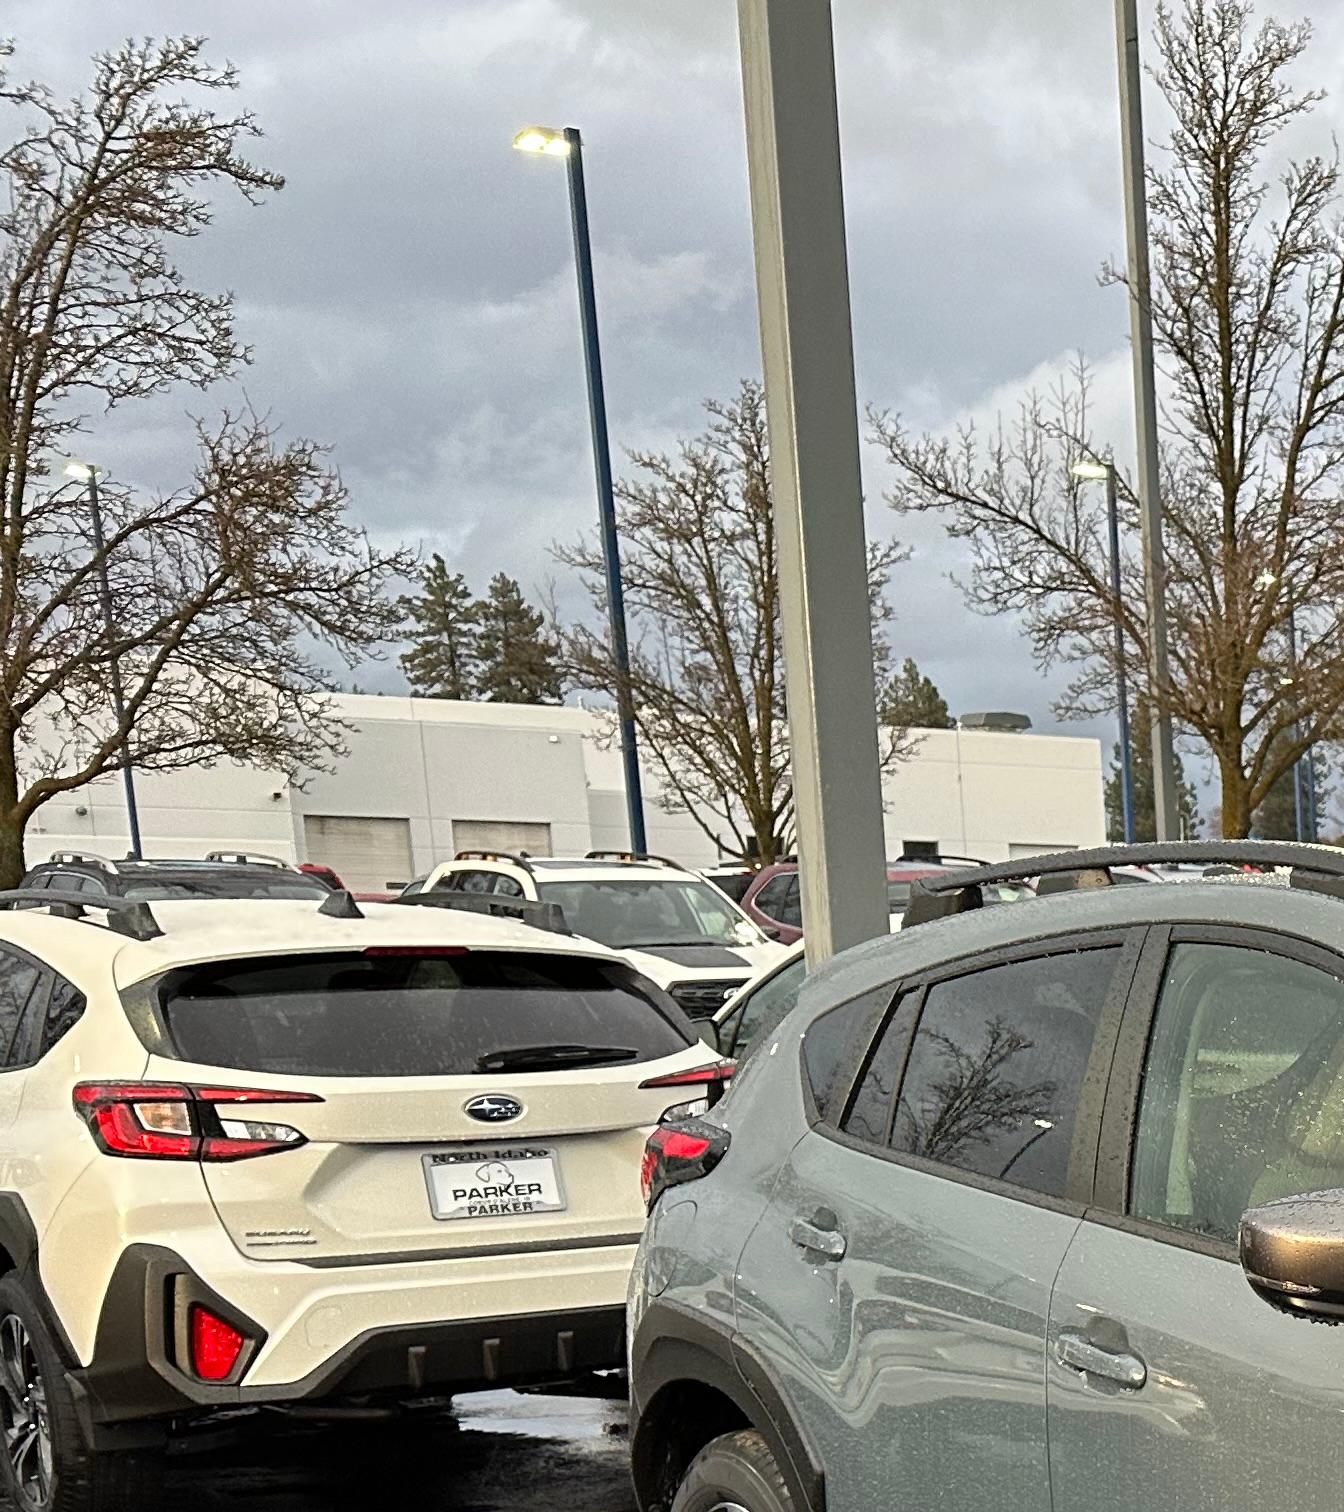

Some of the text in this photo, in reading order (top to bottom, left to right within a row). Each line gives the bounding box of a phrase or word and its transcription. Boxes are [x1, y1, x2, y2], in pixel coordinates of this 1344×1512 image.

[432, 1148, 549, 1164] North Idaho
[452, 1183, 543, 1201] PARKER
[467, 1202, 534, 1216] PARKER
